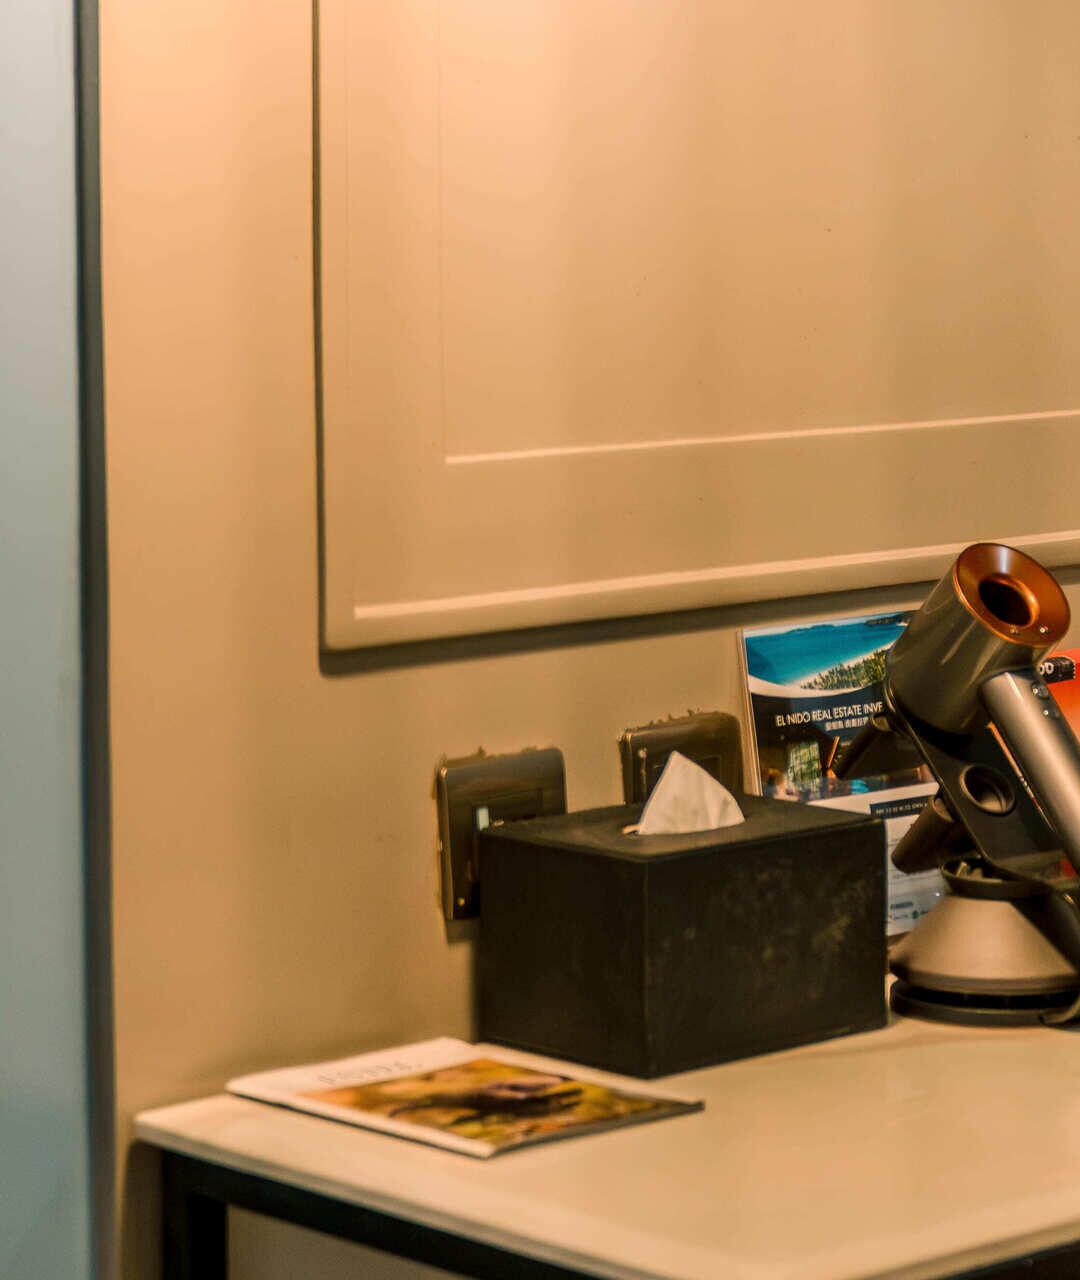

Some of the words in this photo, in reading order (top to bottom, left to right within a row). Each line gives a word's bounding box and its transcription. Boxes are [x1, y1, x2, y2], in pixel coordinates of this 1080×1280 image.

[775, 715, 786, 727] EL
[787, 712, 811, 725] NIDO
[811, 709, 832, 721] REAL
[833, 704, 862, 719] ESTATE
